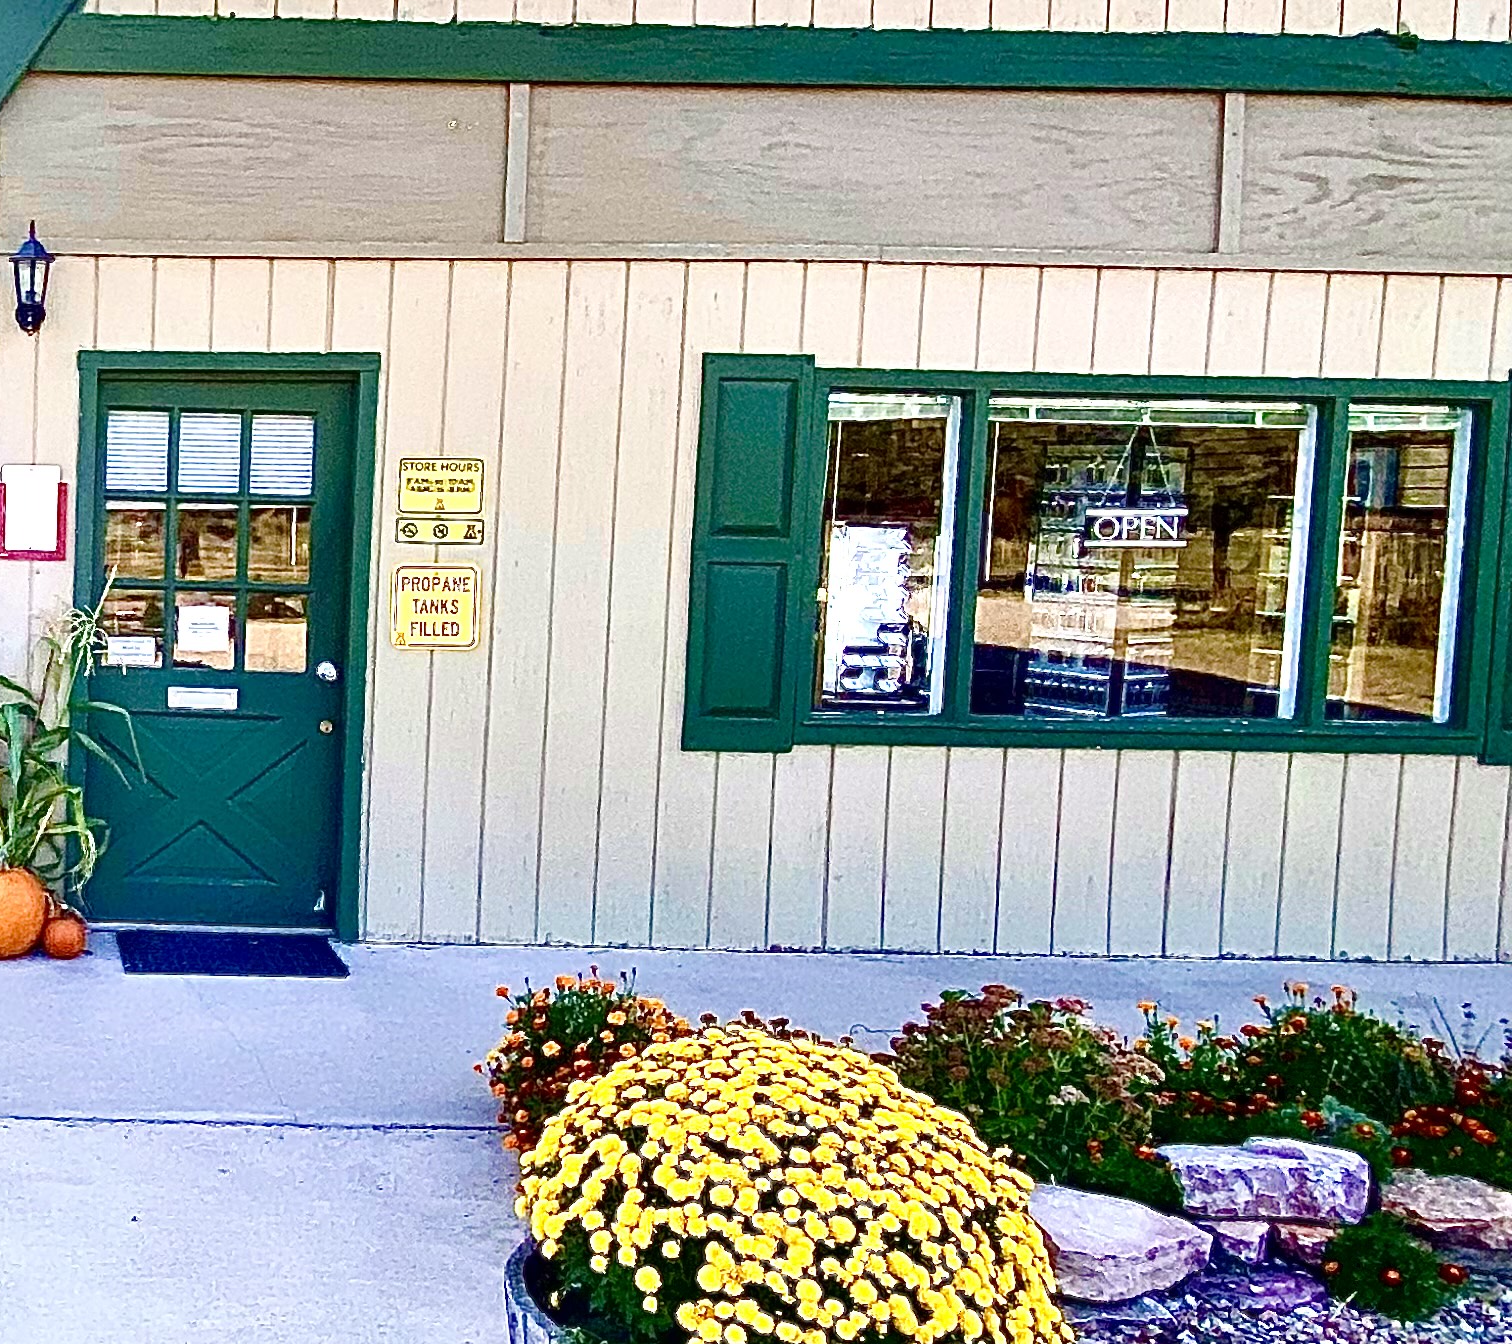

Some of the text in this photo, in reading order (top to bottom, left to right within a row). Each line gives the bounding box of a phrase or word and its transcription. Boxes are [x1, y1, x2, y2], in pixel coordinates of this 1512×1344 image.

[402, 461, 480, 473] STORE HOURS
[1093, 516, 1179, 540] OPEN
[401, 576, 471, 593] PROPANE
[412, 598, 459, 615] TANKS
[410, 621, 460, 637] FILLED
